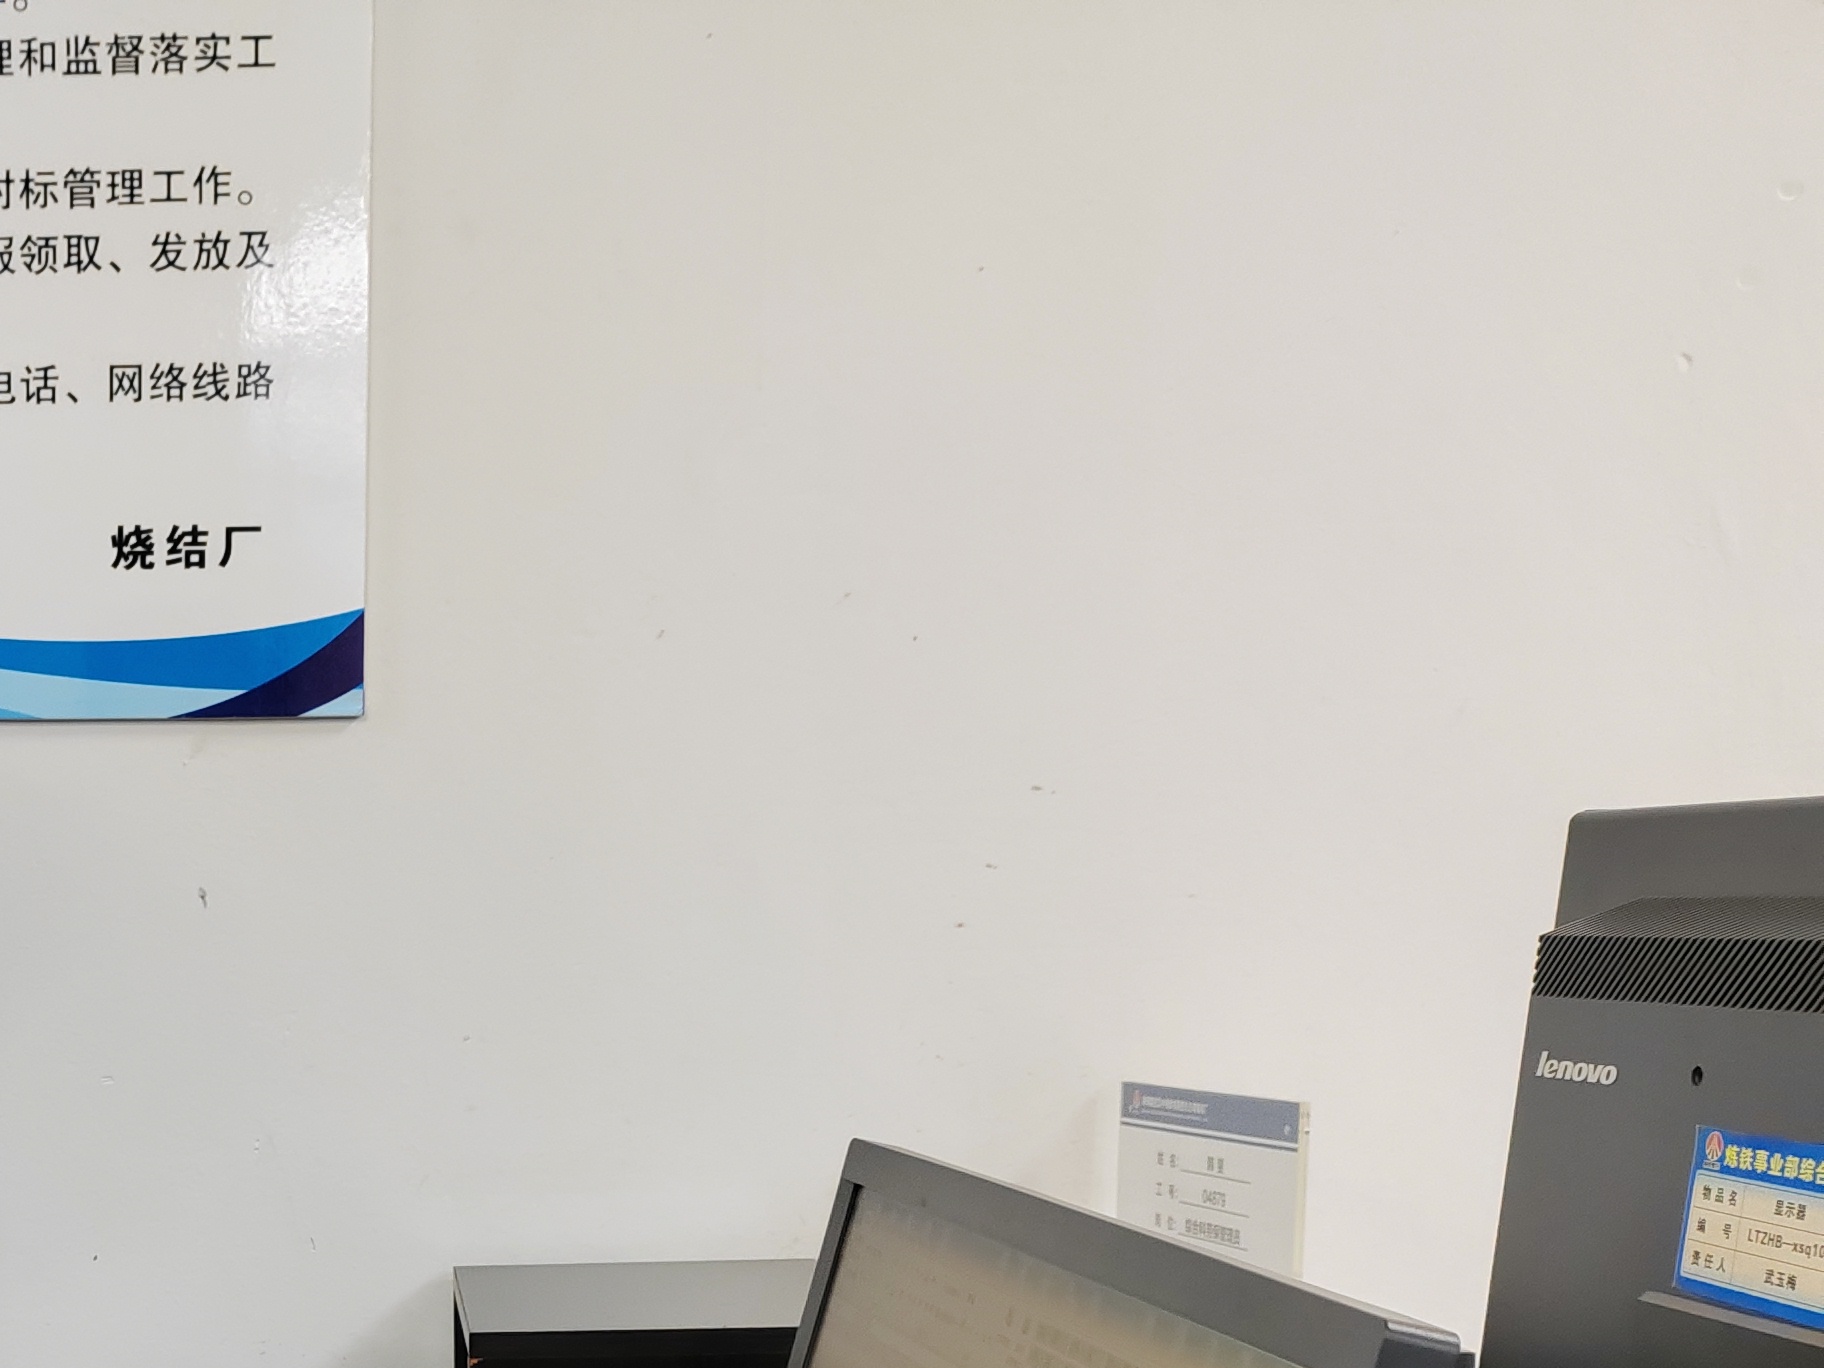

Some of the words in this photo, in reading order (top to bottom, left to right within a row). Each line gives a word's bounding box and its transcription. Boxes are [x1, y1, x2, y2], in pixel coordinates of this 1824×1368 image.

[110, 523, 264, 571] 烧结厂
[1535, 1050, 1618, 1085] lenovo
